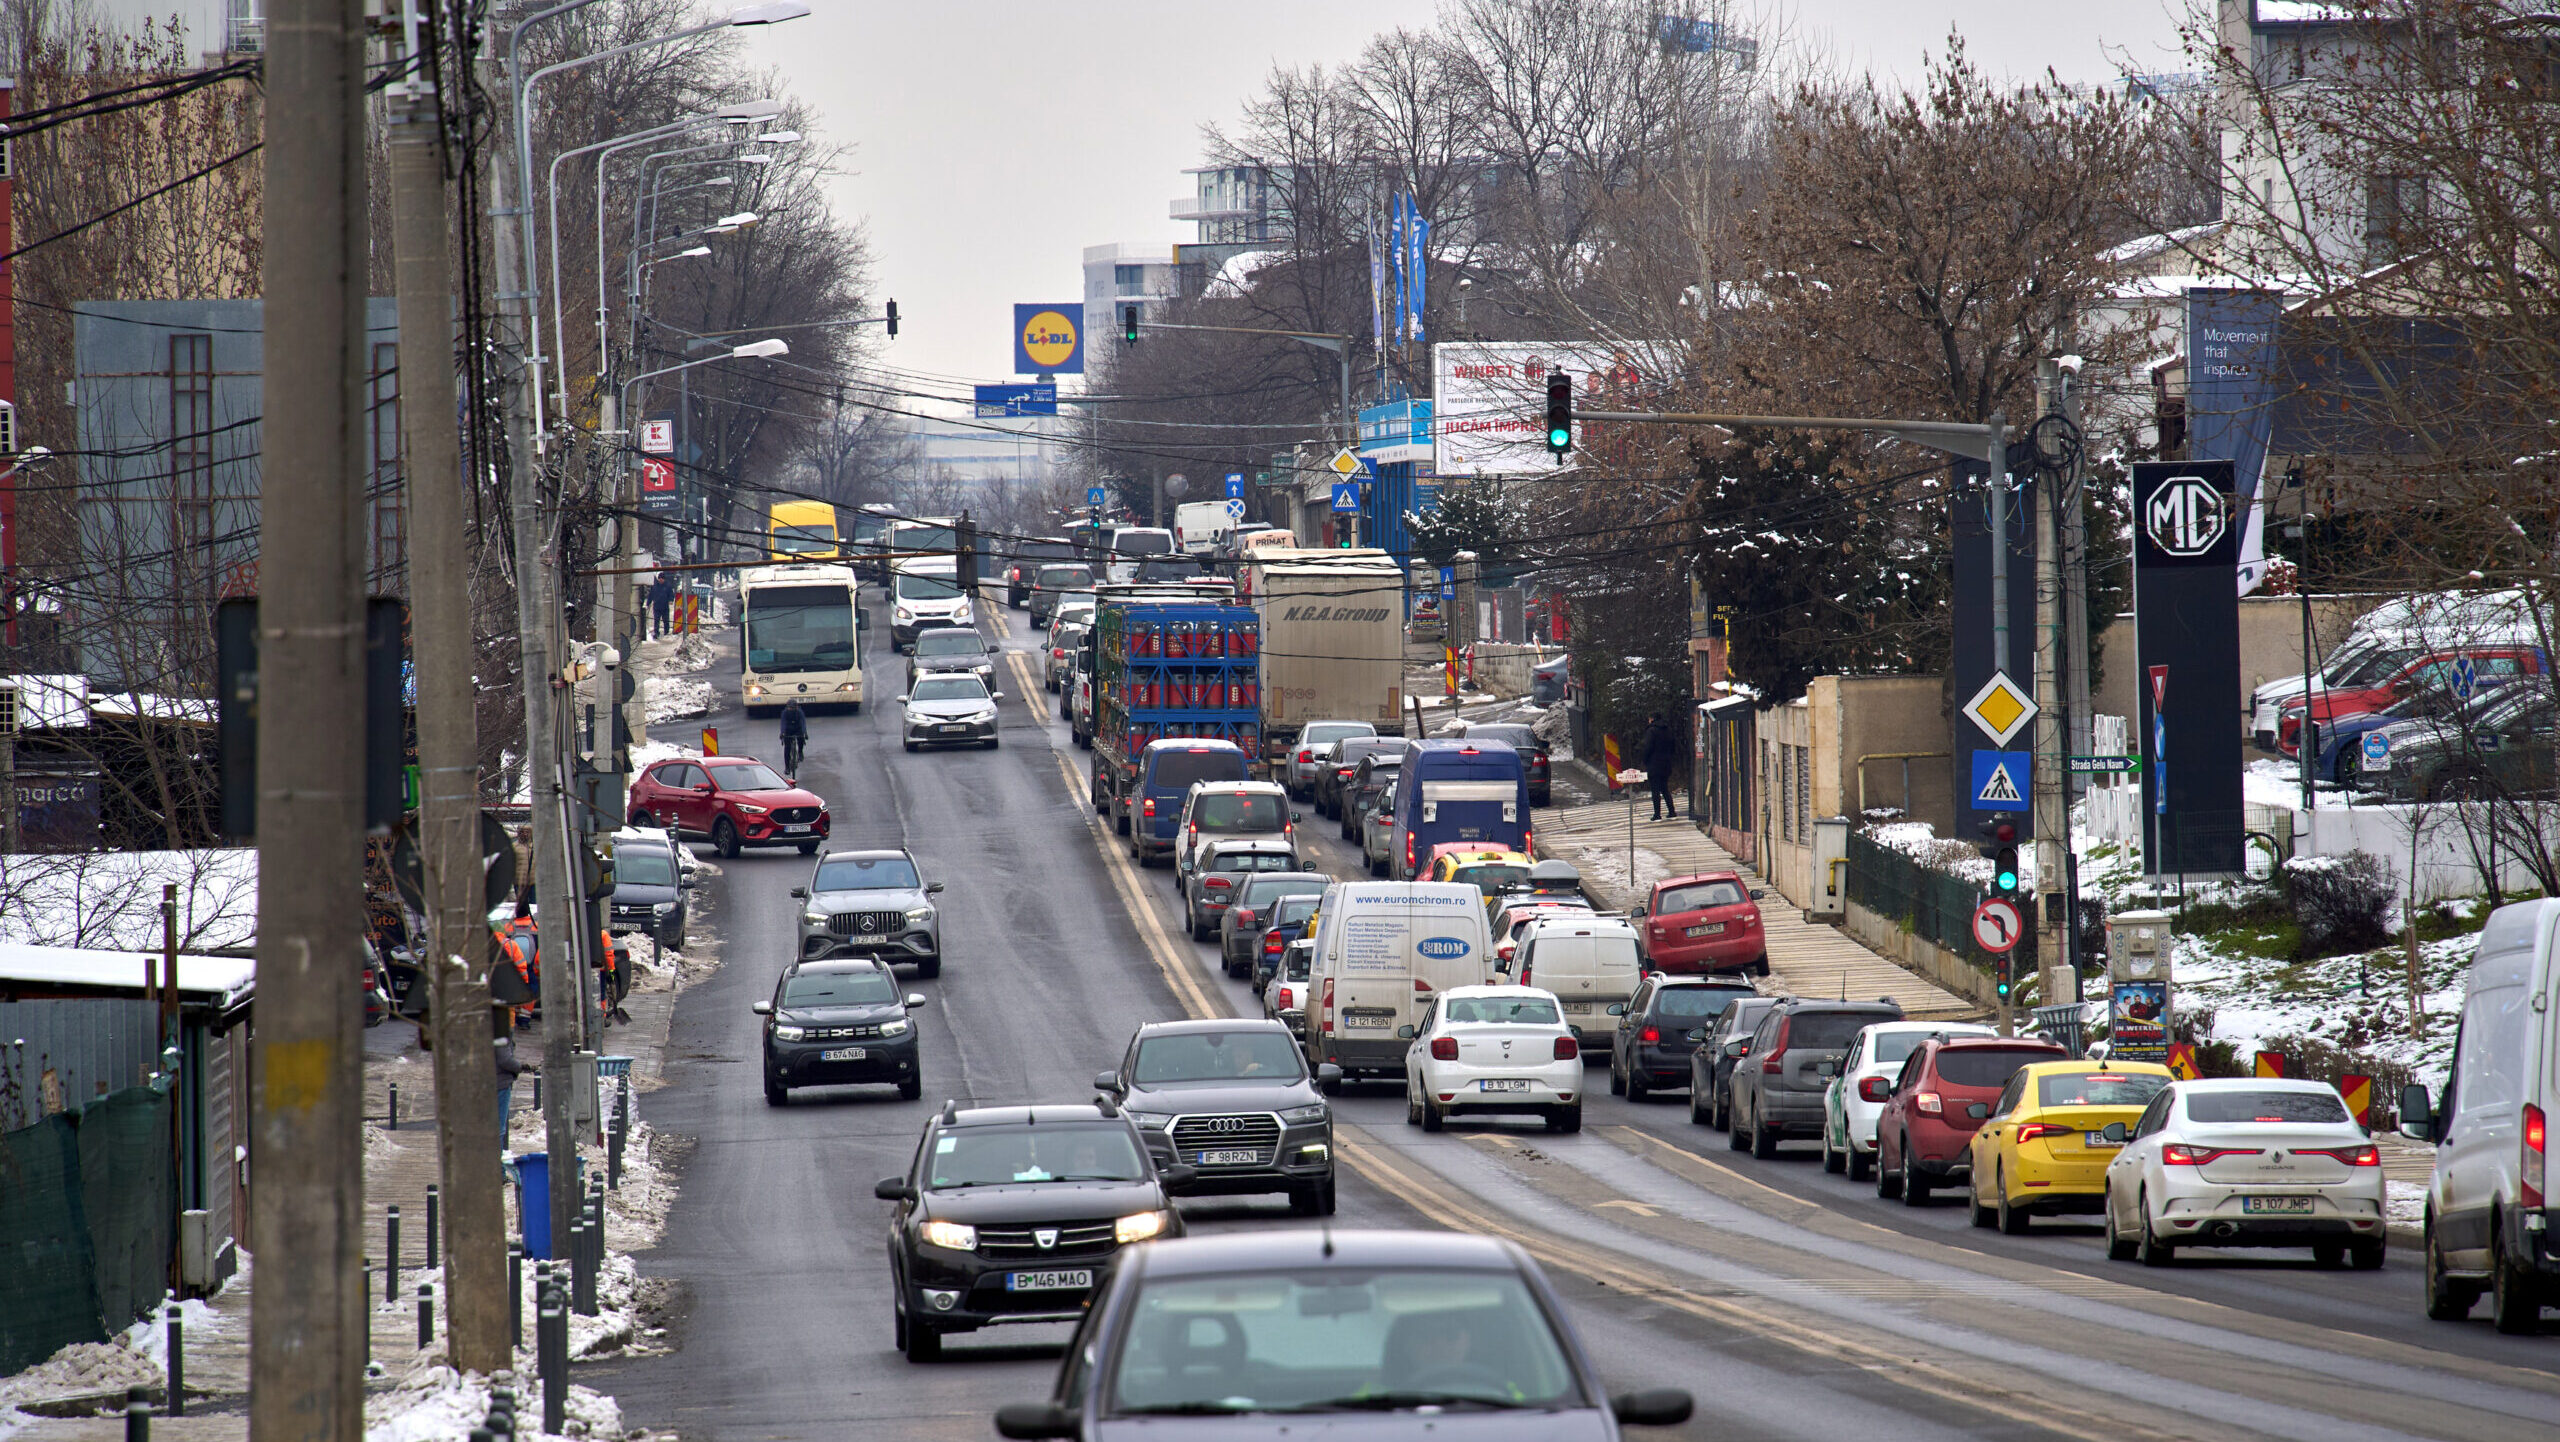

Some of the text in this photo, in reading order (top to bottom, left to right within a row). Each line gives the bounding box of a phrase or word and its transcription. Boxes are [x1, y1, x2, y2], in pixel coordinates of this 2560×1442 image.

[1026, 327, 1073, 345] LIDL
[2204, 328, 2268, 342] Movement
[2205, 346, 2229, 358] that
[1454, 365, 1515, 378] WINBET
[2204, 361, 2248, 377] inspires
[1446, 418, 1547, 435] JUCĂM ÎMPREU
[2154, 485, 2217, 548] MG
[1255, 537, 1286, 546] PRIMAT
[1283, 606, 1390, 623] N.G.A.Group
[2071, 759, 2125, 770] Strada Gelu Naum
[1356, 895, 1466, 905] www.euromchrom.ro
[1351, 1017, 1388, 1025] B 121 RBN
[825, 1051, 831, 1060] B
[834, 1051, 847, 1059] 674
[1487, 1081, 1526, 1089] B 10 LGM
[2095, 1133, 2102, 1143] B
[1205, 1151, 1254, 1162] IF 98 RZN
[2253, 1198, 2310, 1209] B 107 JMP
[1017, 1271, 1087, 1288] B 146 MAO
